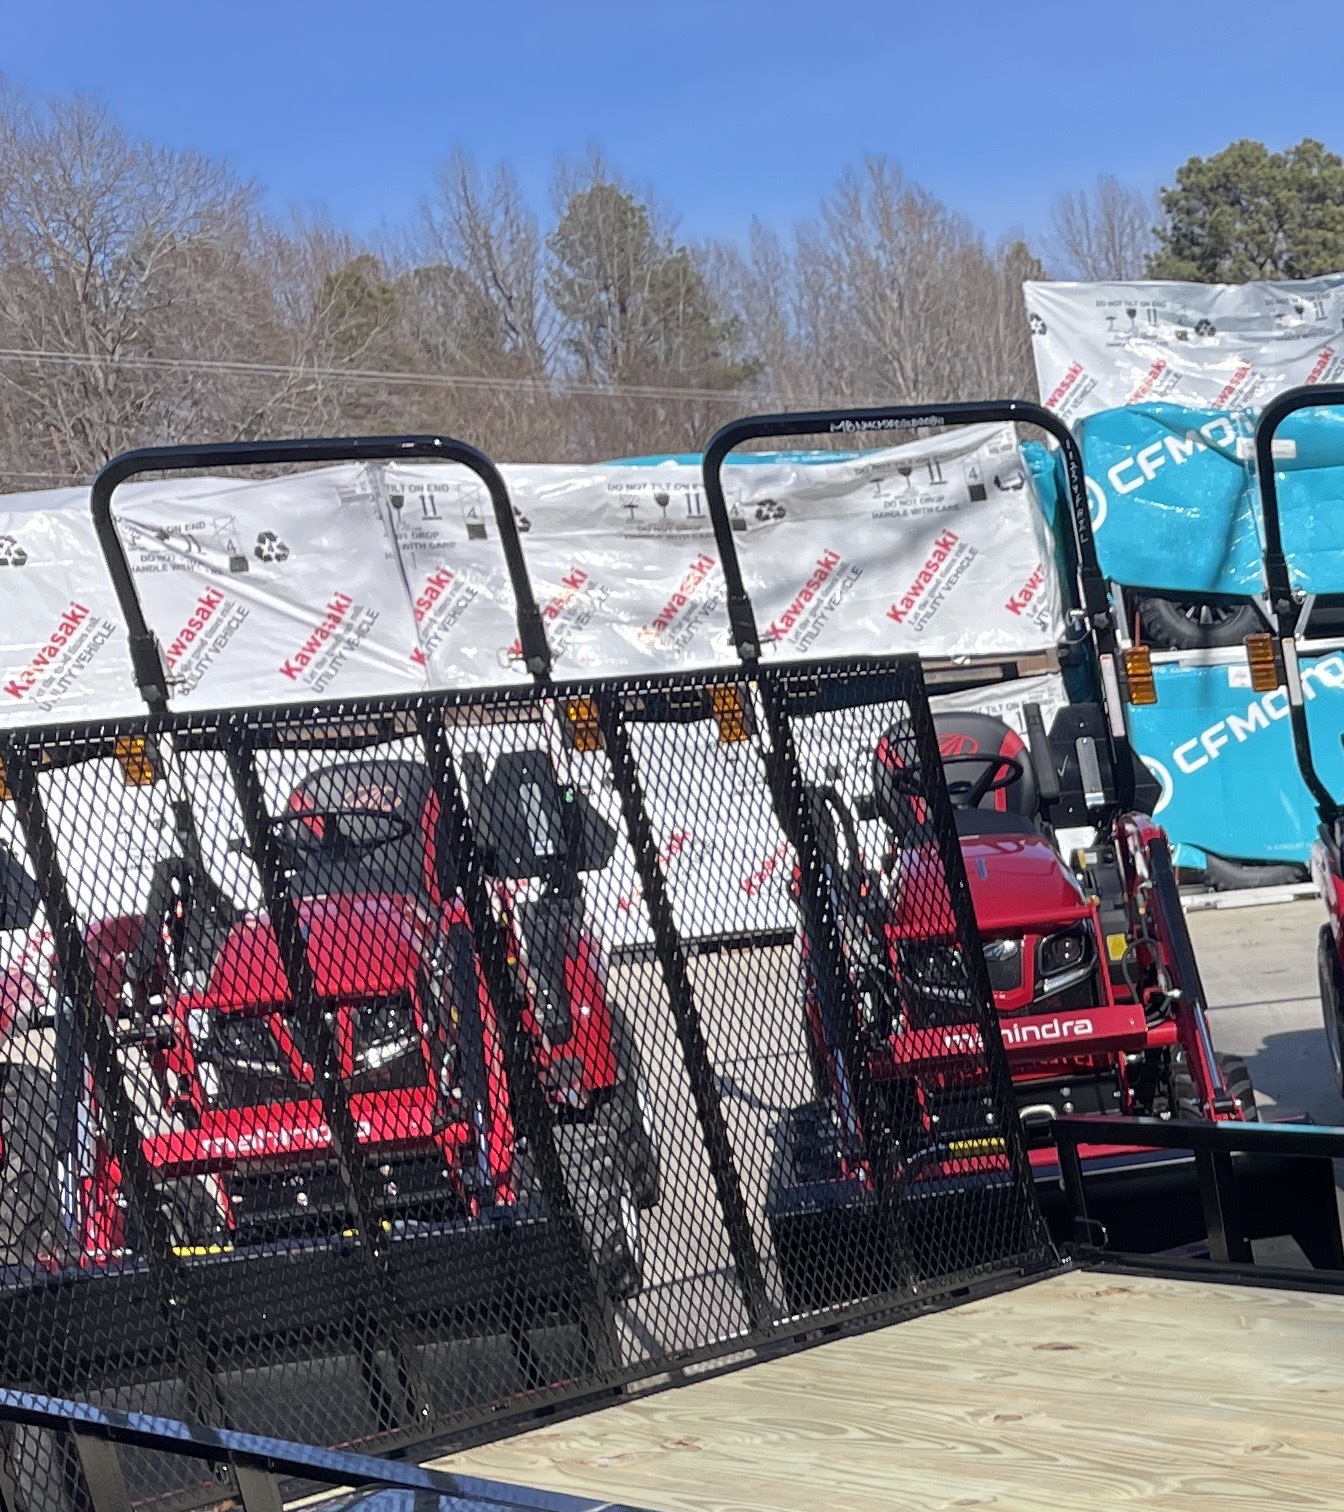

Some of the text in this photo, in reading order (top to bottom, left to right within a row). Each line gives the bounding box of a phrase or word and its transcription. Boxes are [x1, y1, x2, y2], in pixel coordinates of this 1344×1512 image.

[1045, 360, 1085, 408] wasaki
[1305, 345, 1336, 385] asaki
[1107, 413, 1254, 495] CFMO
[638, 552, 717, 642] awasaki
[767, 548, 841, 642] Kawasaki
[887, 529, 959, 624] Kawasaki
[939, 544, 980, 594] VEHICLE
[3, 601, 91, 699] Kawasaki
[38, 618, 117, 715] UILITY VEHICLE
[166, 586, 225, 668] awasaki
[206, 604, 251, 657] VEHICLE
[279, 591, 353, 681] Kawasaki
